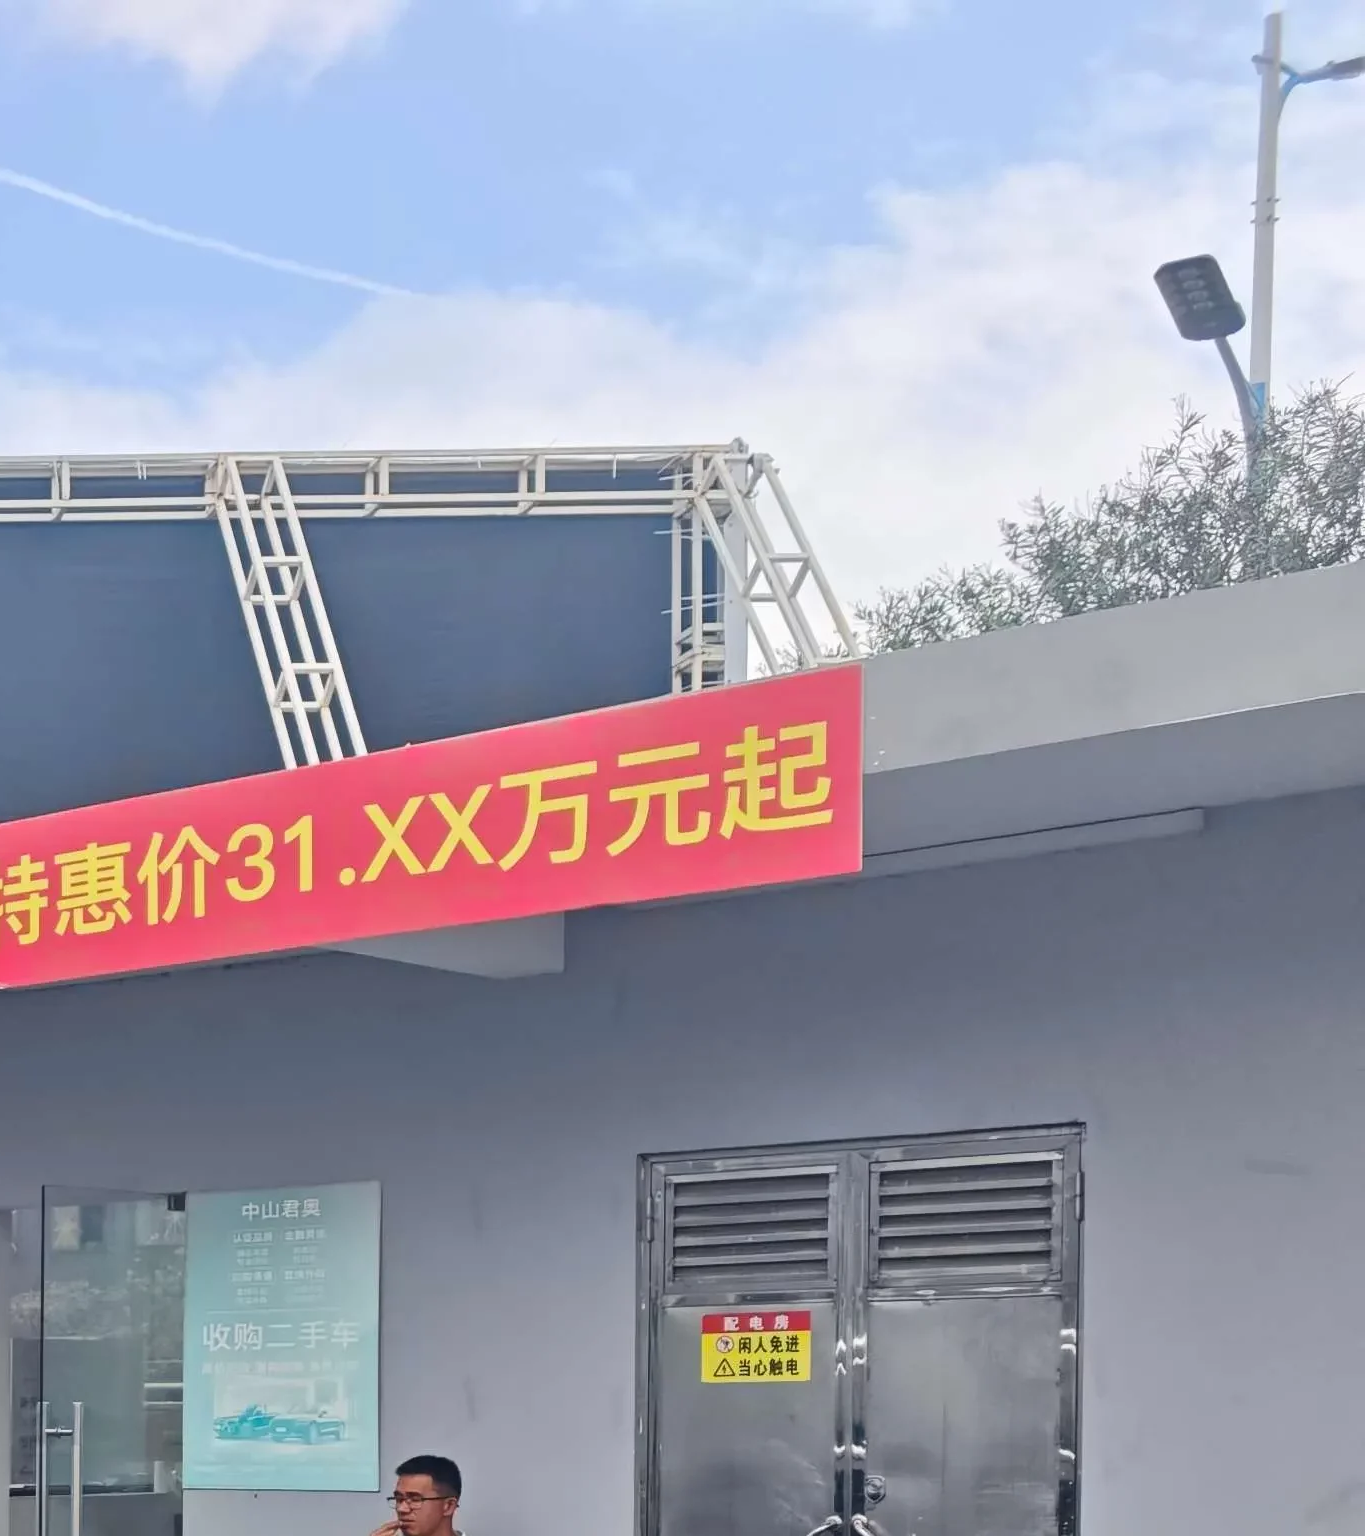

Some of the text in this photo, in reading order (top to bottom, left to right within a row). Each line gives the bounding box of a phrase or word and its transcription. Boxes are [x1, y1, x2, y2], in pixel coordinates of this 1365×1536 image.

[242, 1199, 321, 1221] 中山君奥
[724, 1315, 789, 1331] 配电房
[202, 1321, 360, 1351] 收购二手车
[738, 1335, 800, 1354] 闲人免进
[738, 1358, 799, 1376] 当心触电
